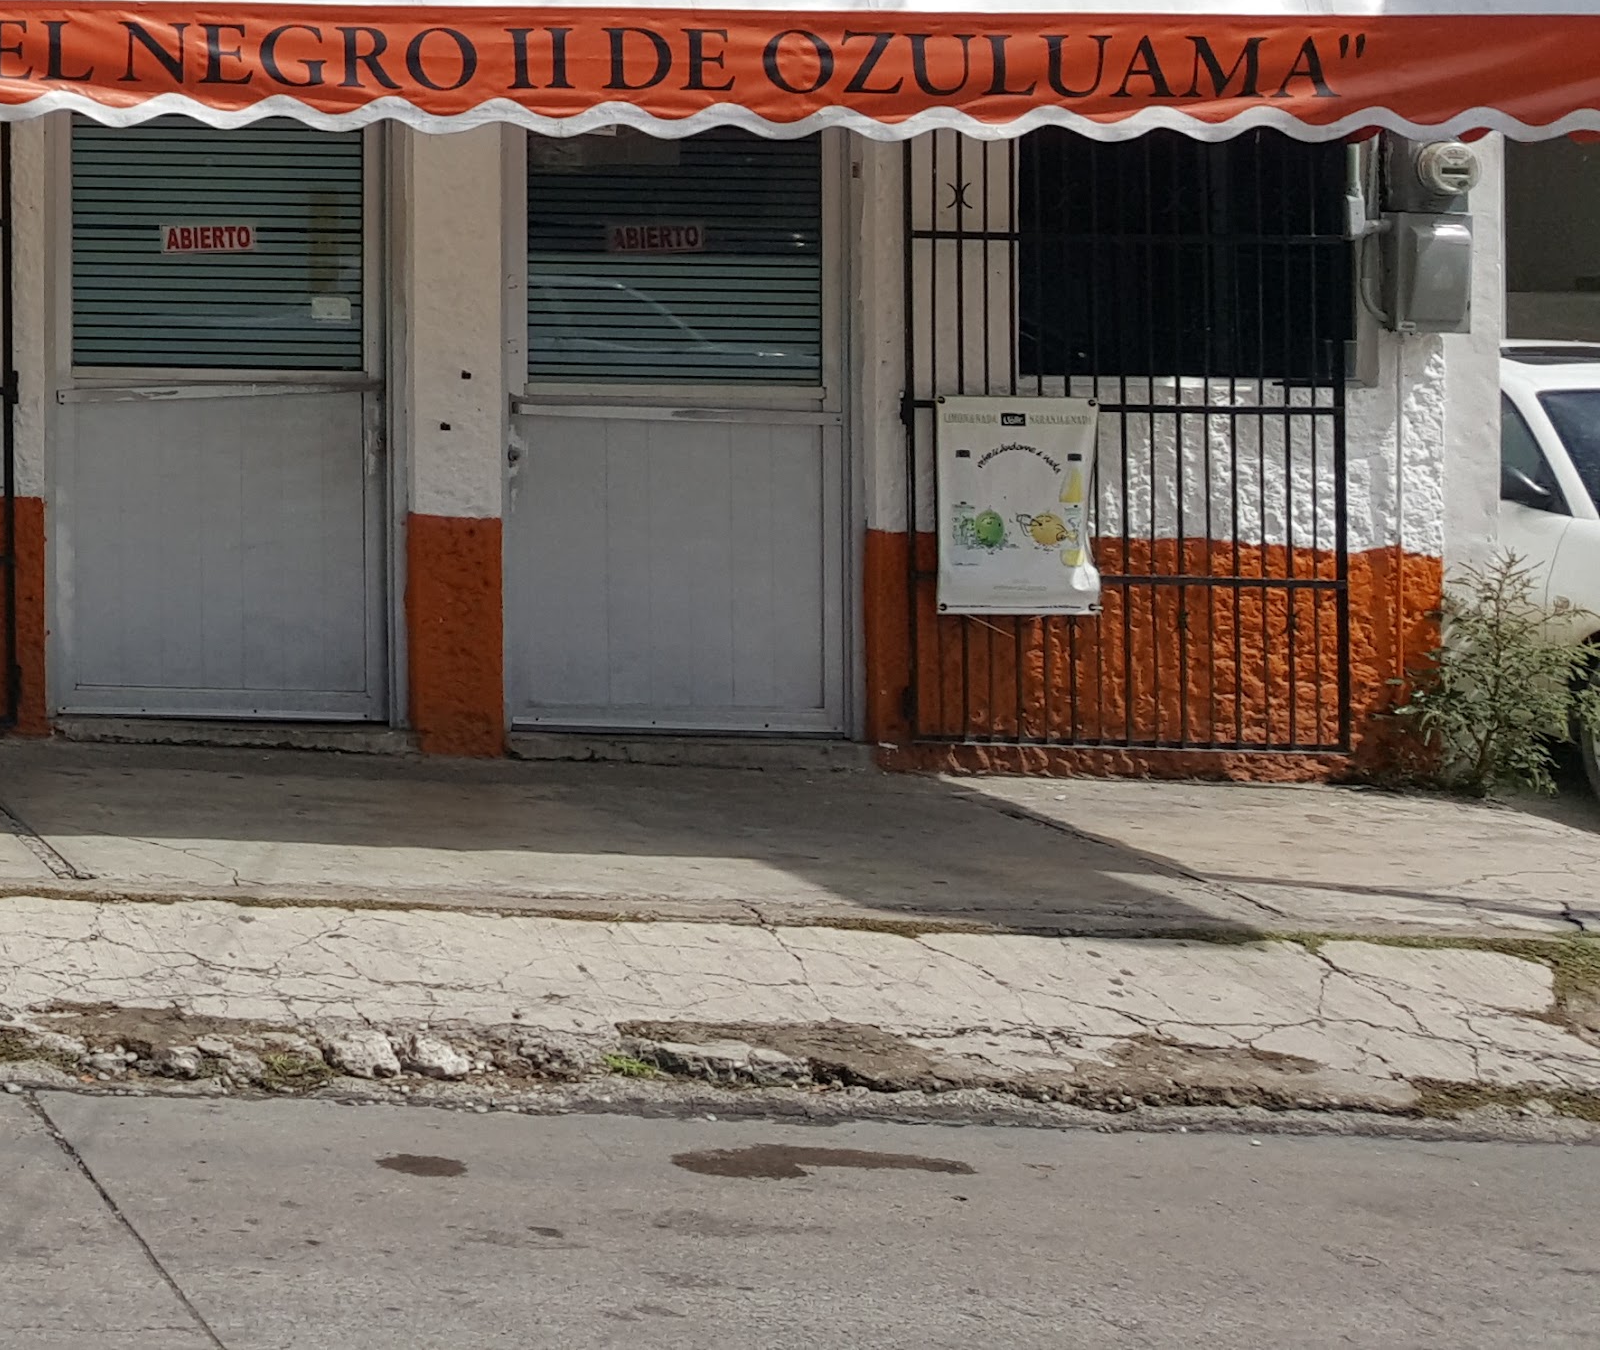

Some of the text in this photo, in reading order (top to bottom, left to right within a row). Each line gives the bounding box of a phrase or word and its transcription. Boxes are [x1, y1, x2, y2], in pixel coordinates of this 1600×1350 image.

[117, 20, 477, 91] NEGRO
[503, 26, 574, 90] II
[601, 26, 736, 92] DE
[761, 28, 1367, 100] OZULUAMA"
[166, 225, 251, 250] ABIERTO
[612, 225, 699, 250] ABIERTO
